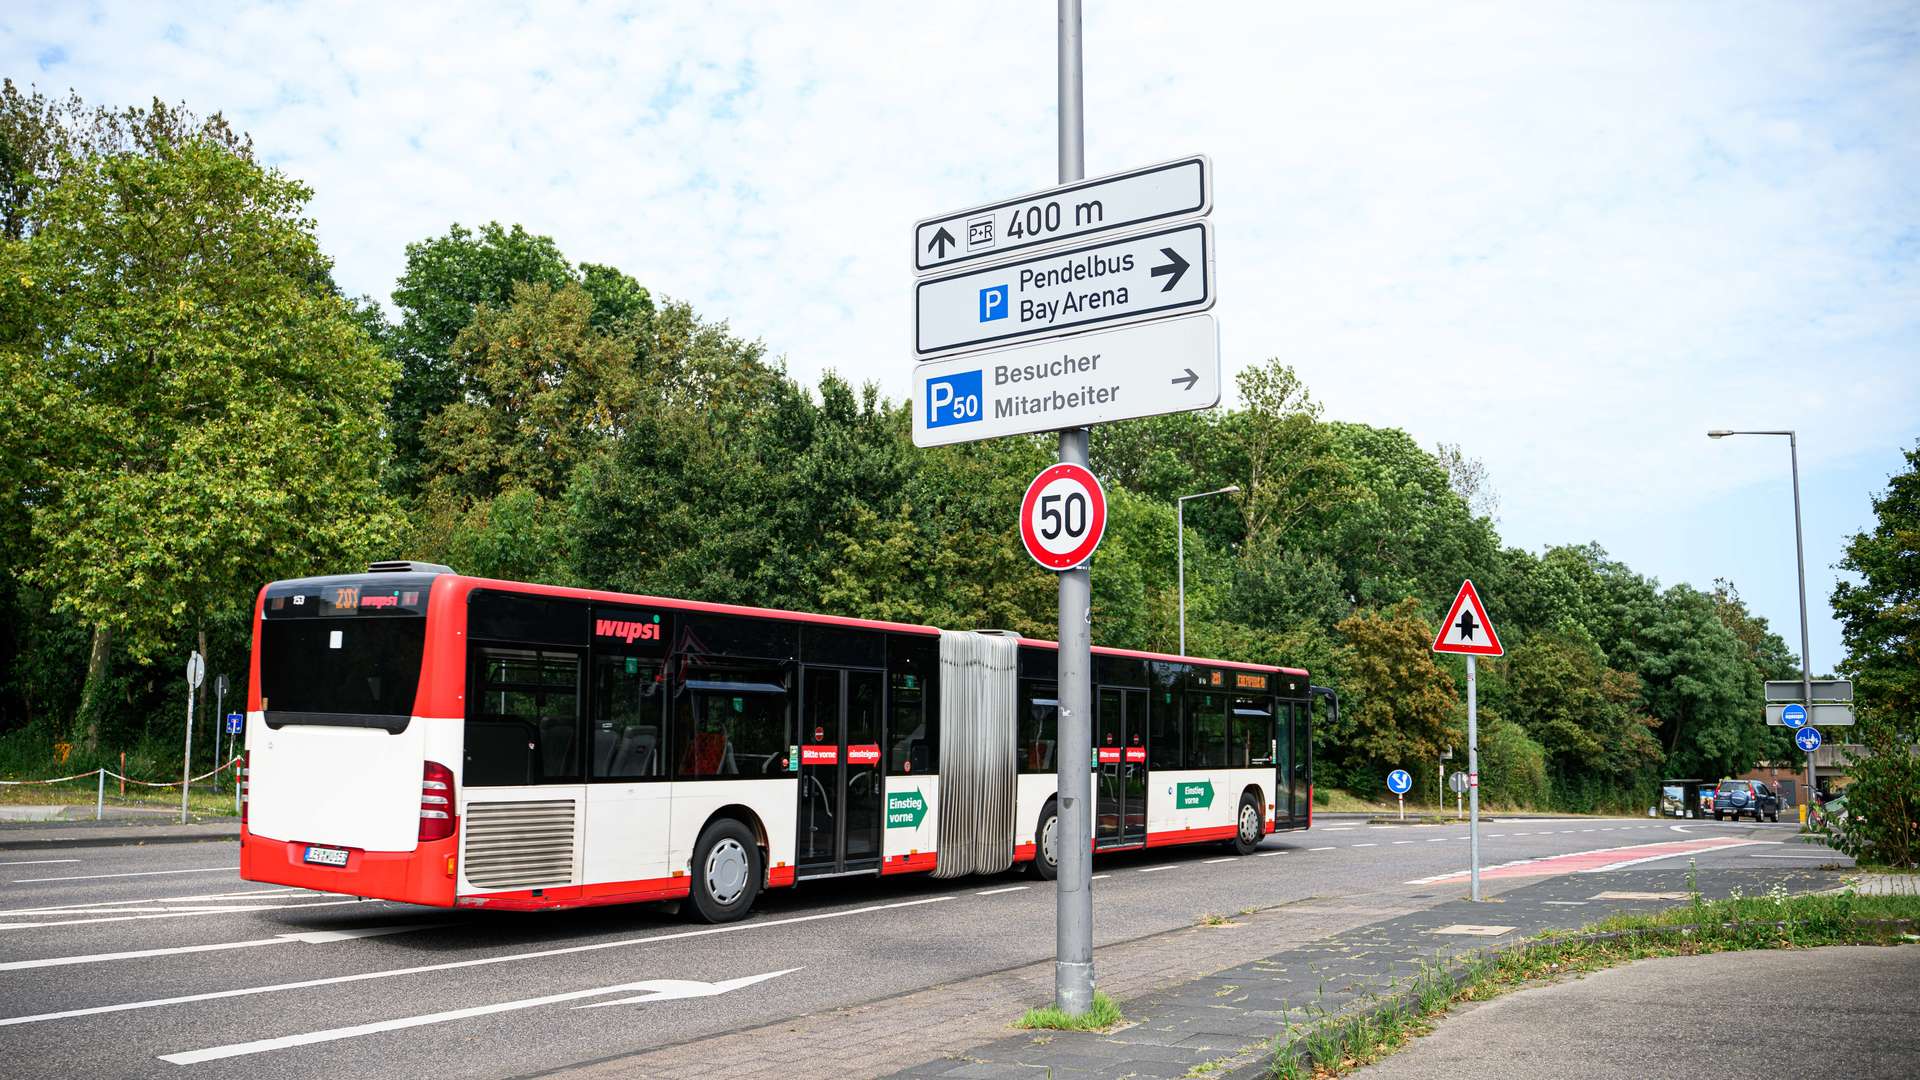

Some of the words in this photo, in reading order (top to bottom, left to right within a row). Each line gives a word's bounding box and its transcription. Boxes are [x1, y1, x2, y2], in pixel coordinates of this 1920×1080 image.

[969, 224, 993, 242] P+R
[1007, 201, 1060, 239] 400
[1076, 200, 1103, 226] m
[1020, 254, 1135, 292] Pendelbus
[985, 290, 1002, 318] P
[994, 354, 1101, 386] Besucher
[994, 385, 1120, 419] Mitarbeiter
[1041, 492, 1086, 540] 50
[360, 591, 399, 609] wupsi
[595, 614, 660, 644] wupsi
[803, 751, 818, 759] Bitte
[818, 751, 837, 759] vorne
[849, 750, 879, 760] einsteigen
[889, 797, 922, 810] Einstieg
[1184, 786, 1204, 797] Einstieg
[889, 812, 914, 823] vorne
